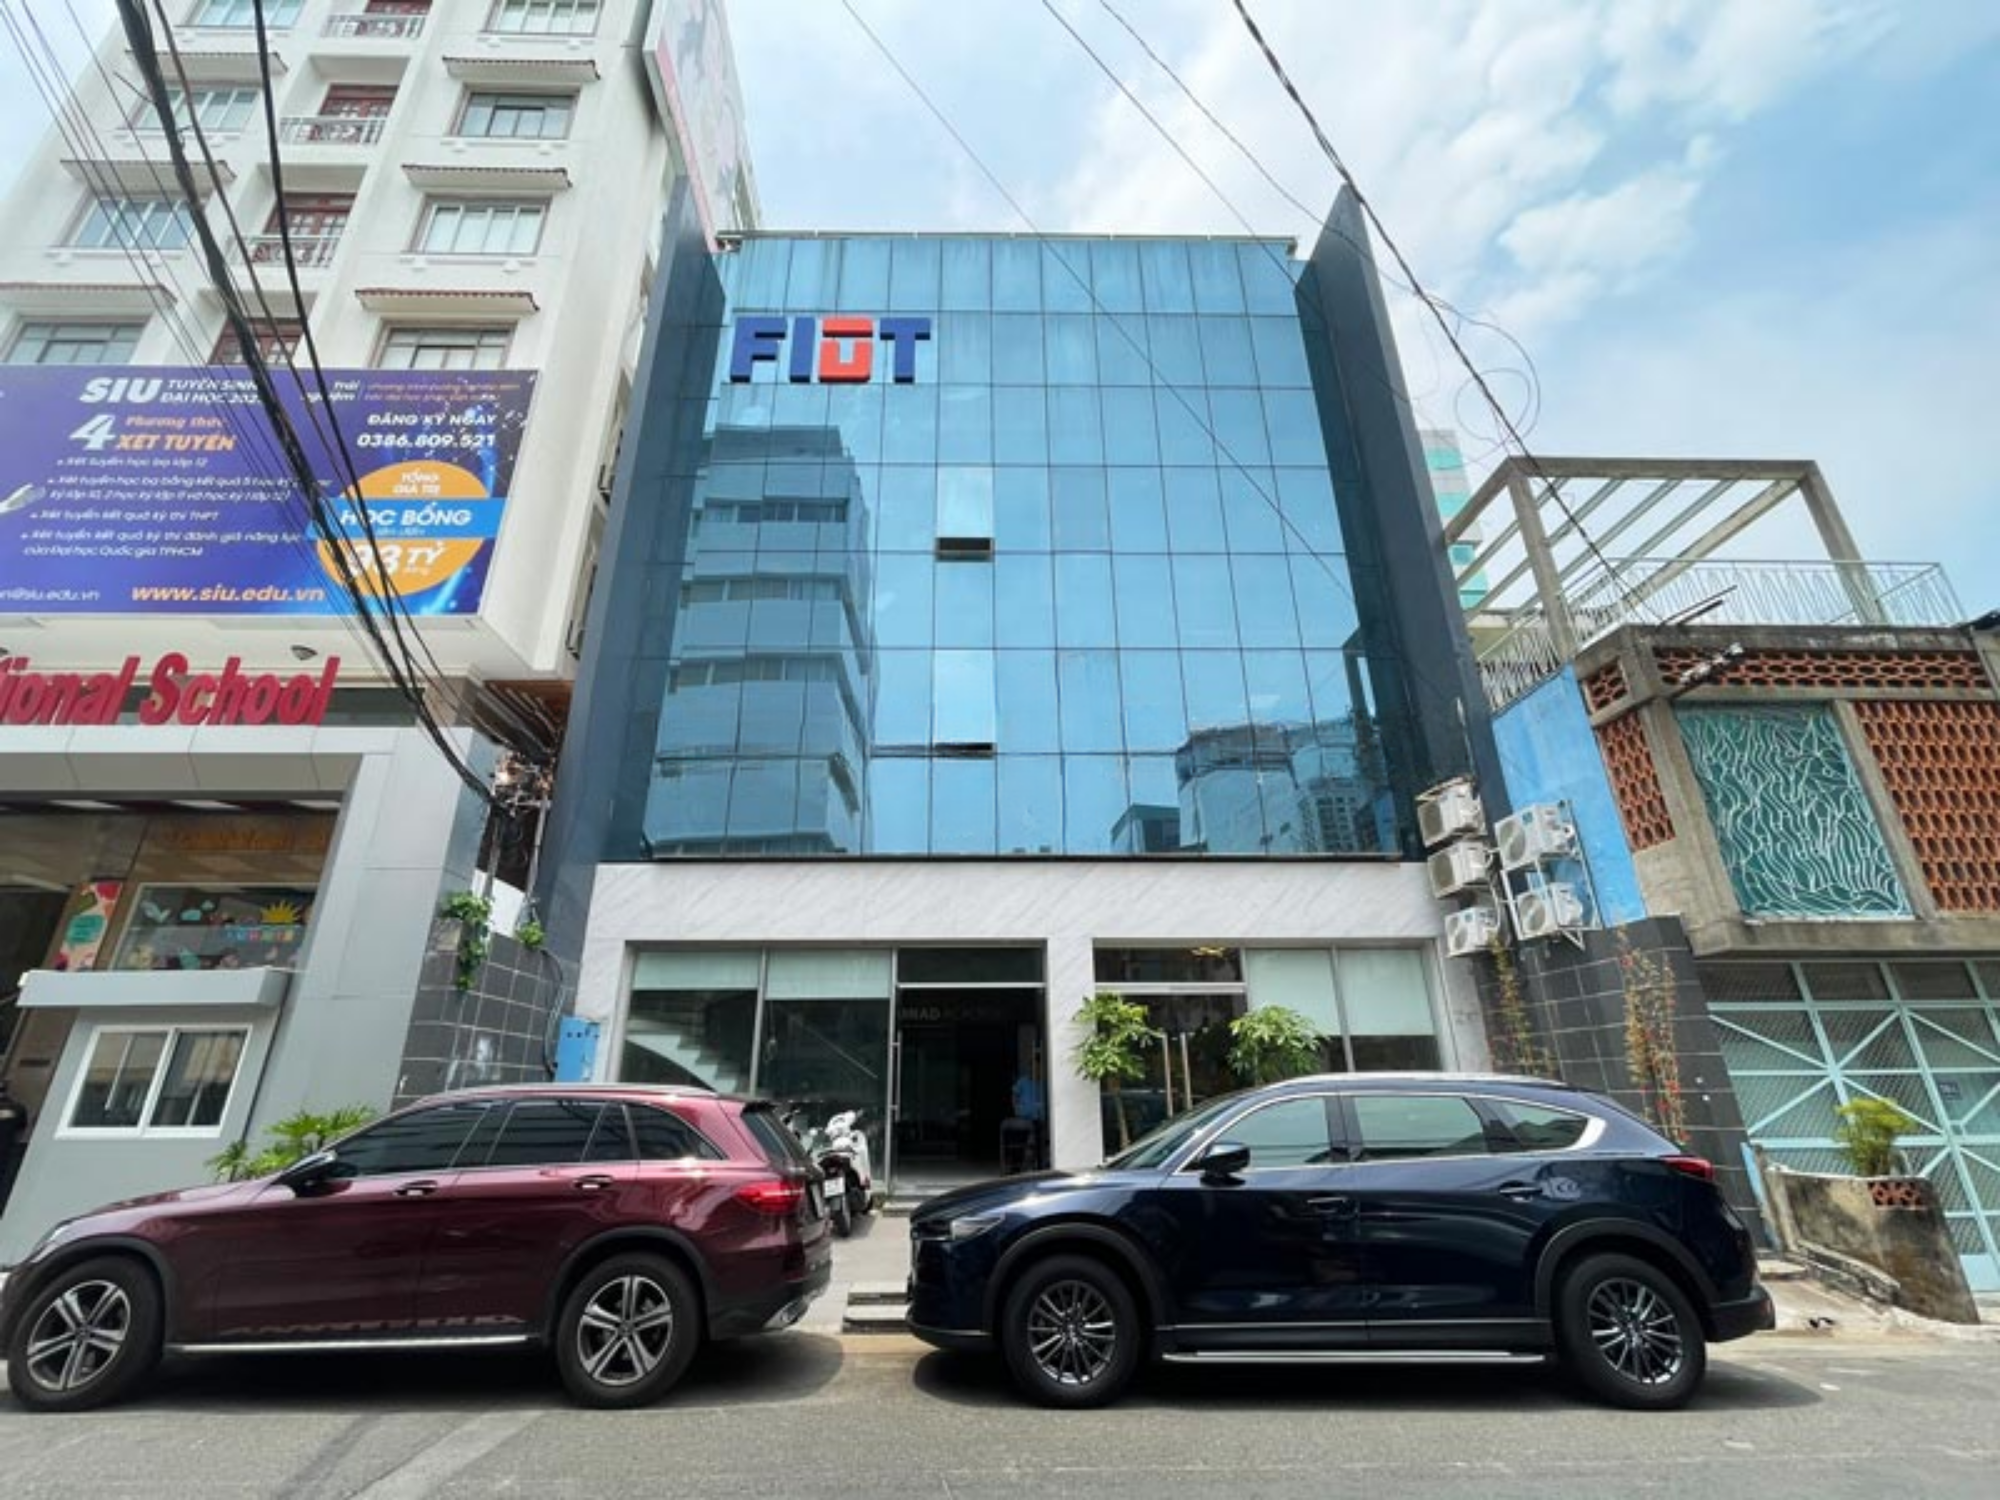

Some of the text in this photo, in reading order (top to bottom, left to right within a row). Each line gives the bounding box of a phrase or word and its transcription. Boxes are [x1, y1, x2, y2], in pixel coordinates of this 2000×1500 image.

[79, 377, 163, 403] SIU
[69, 414, 117, 450] 4
[401, 501, 473, 527] BỔNG
[131, 583, 326, 602] www.siu.edu.vn
[139, 651, 341, 726] School
